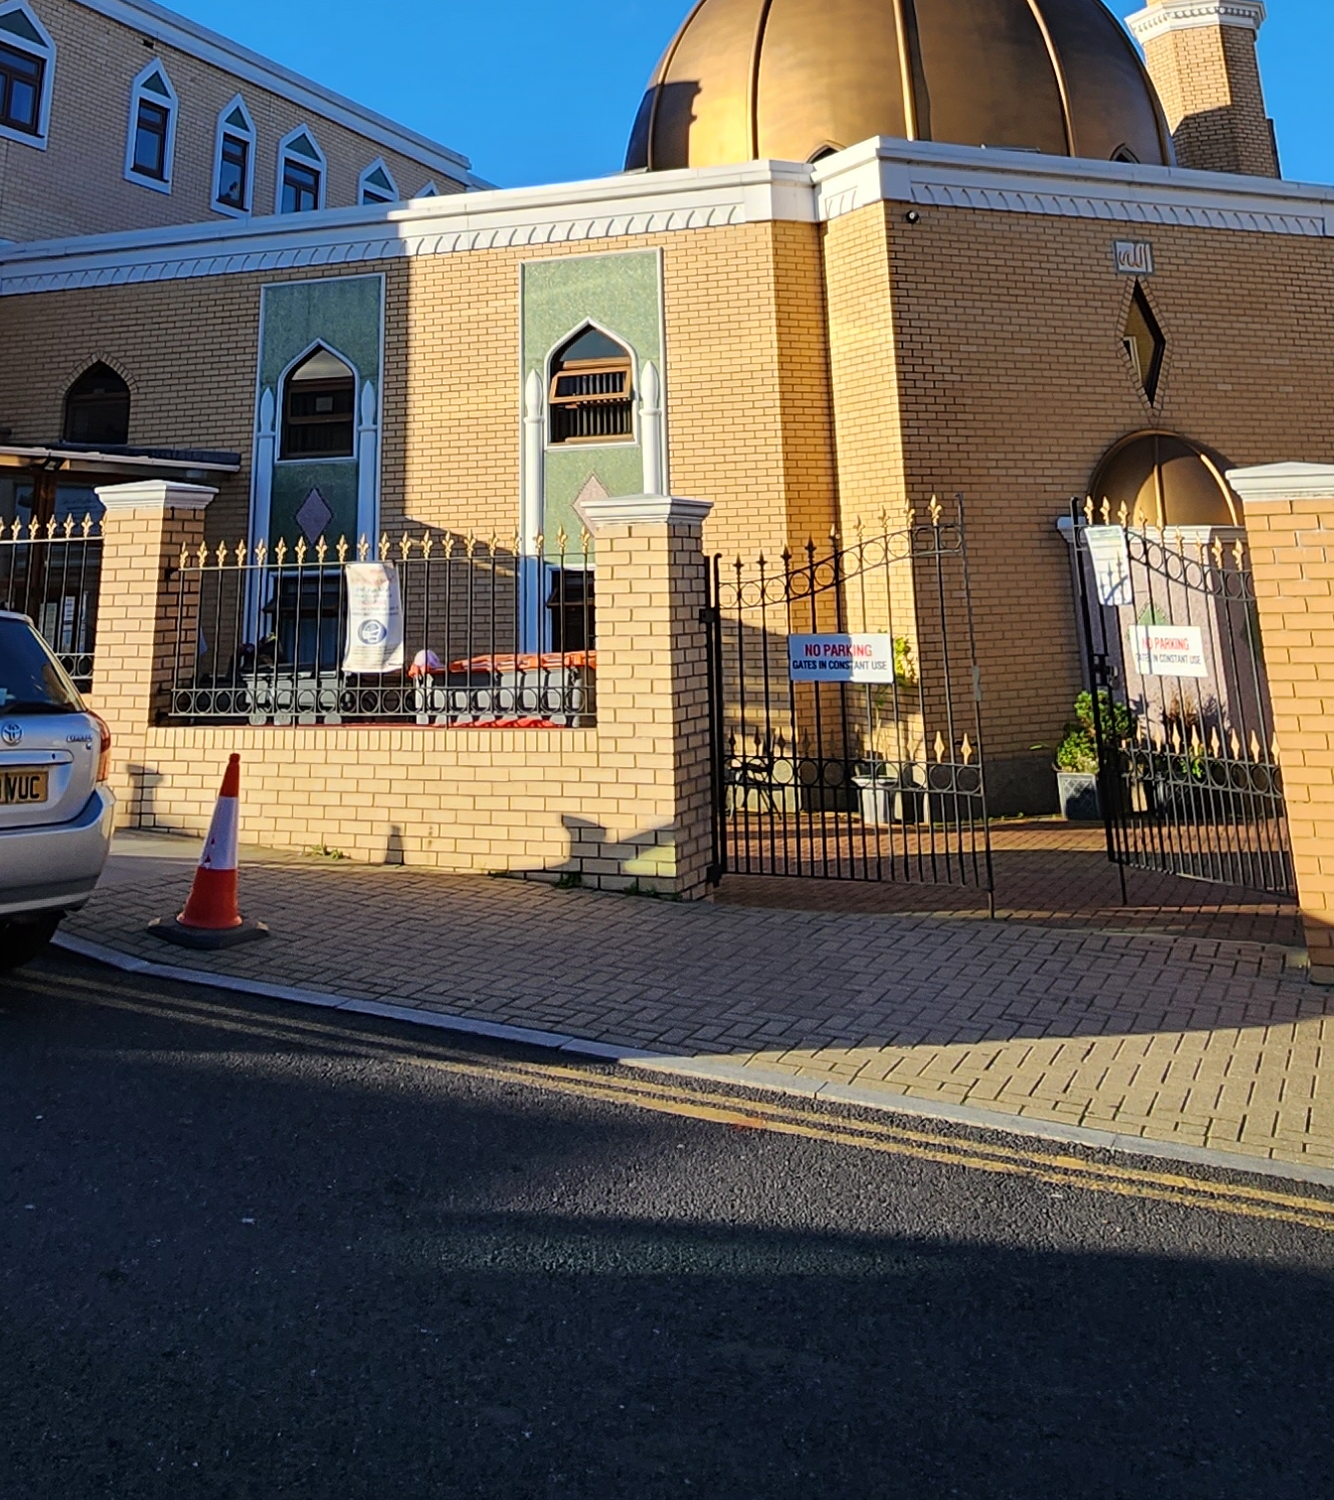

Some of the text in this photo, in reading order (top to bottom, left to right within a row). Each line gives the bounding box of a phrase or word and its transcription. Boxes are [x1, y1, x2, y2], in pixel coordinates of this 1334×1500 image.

[1154, 637, 1189, 651] PARKING
[805, 644, 872, 657] NO PARKING
[792, 660, 887, 670] GATES IN CONSTANT USE
[1159, 654, 1188, 664] CONSTANT
[1189, 655, 1201, 665] USE
